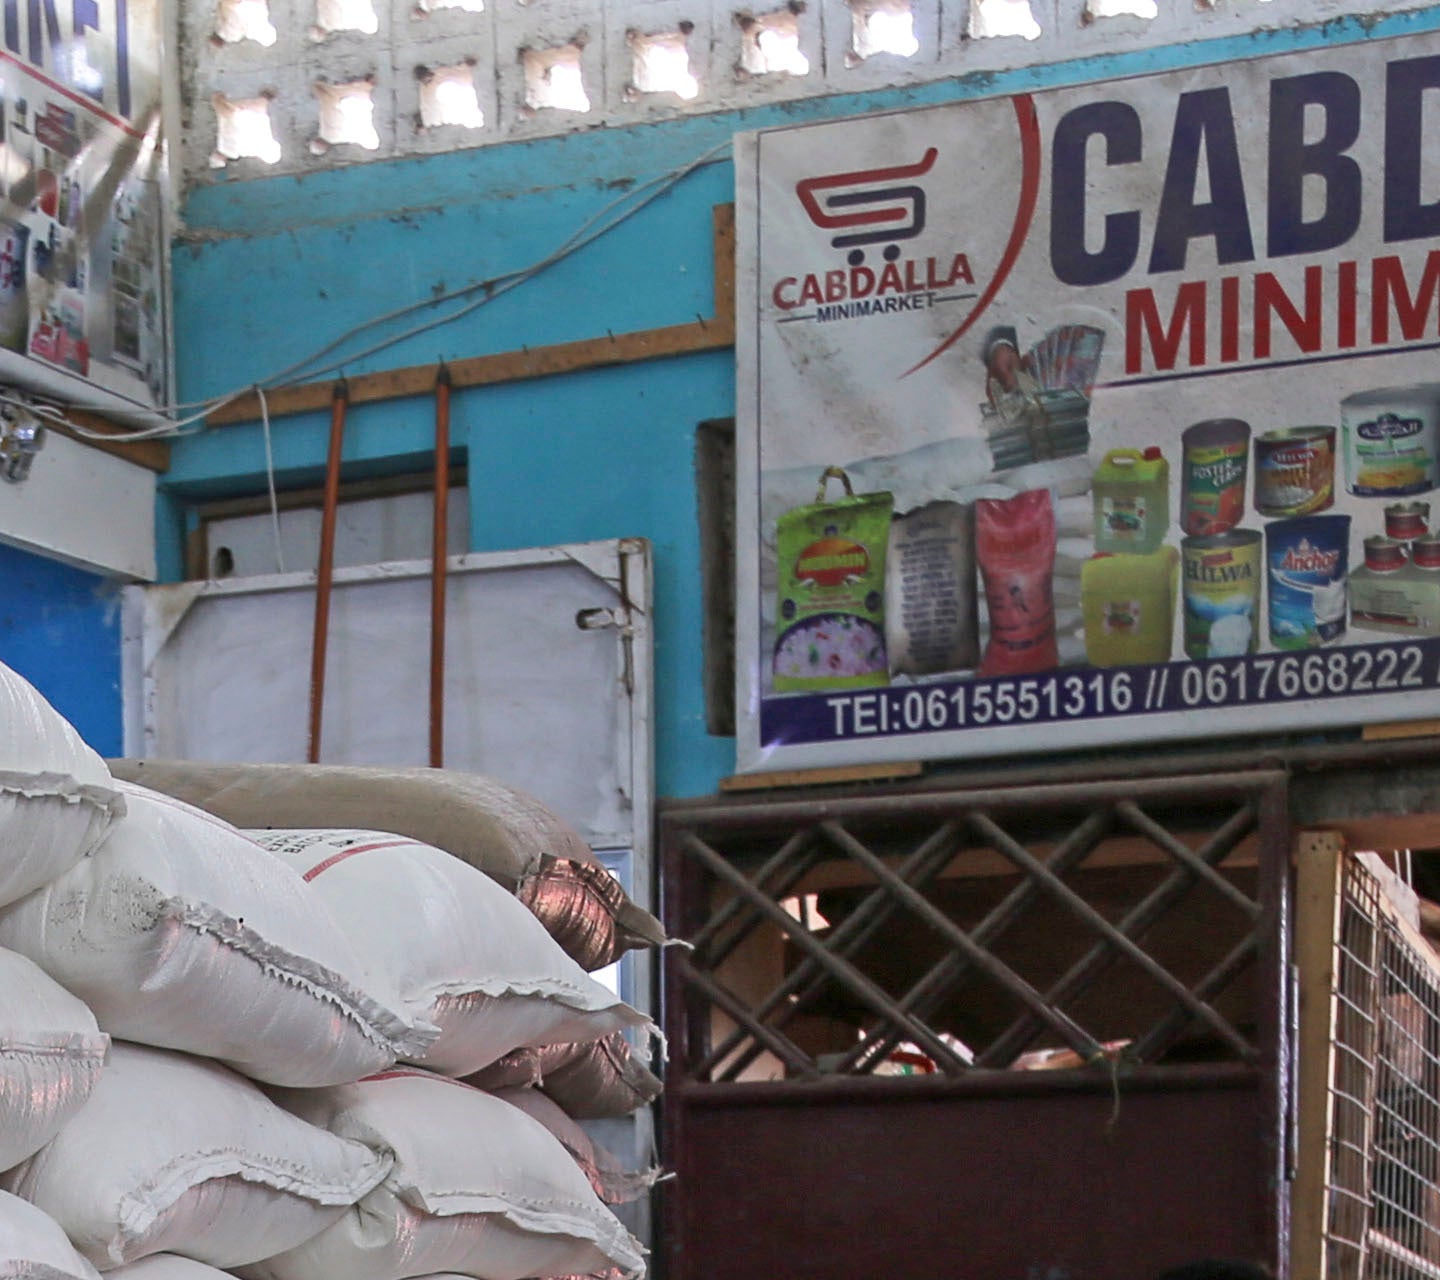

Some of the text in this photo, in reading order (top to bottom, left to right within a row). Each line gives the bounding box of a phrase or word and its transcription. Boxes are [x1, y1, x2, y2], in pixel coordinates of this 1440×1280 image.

[773, 253, 975, 311] CABDALLA
[816, 292, 937, 323] MINIMARKET
[1281, 550, 1339, 574] Anchor
[1182, 645, 1425, 704] 0617668222
